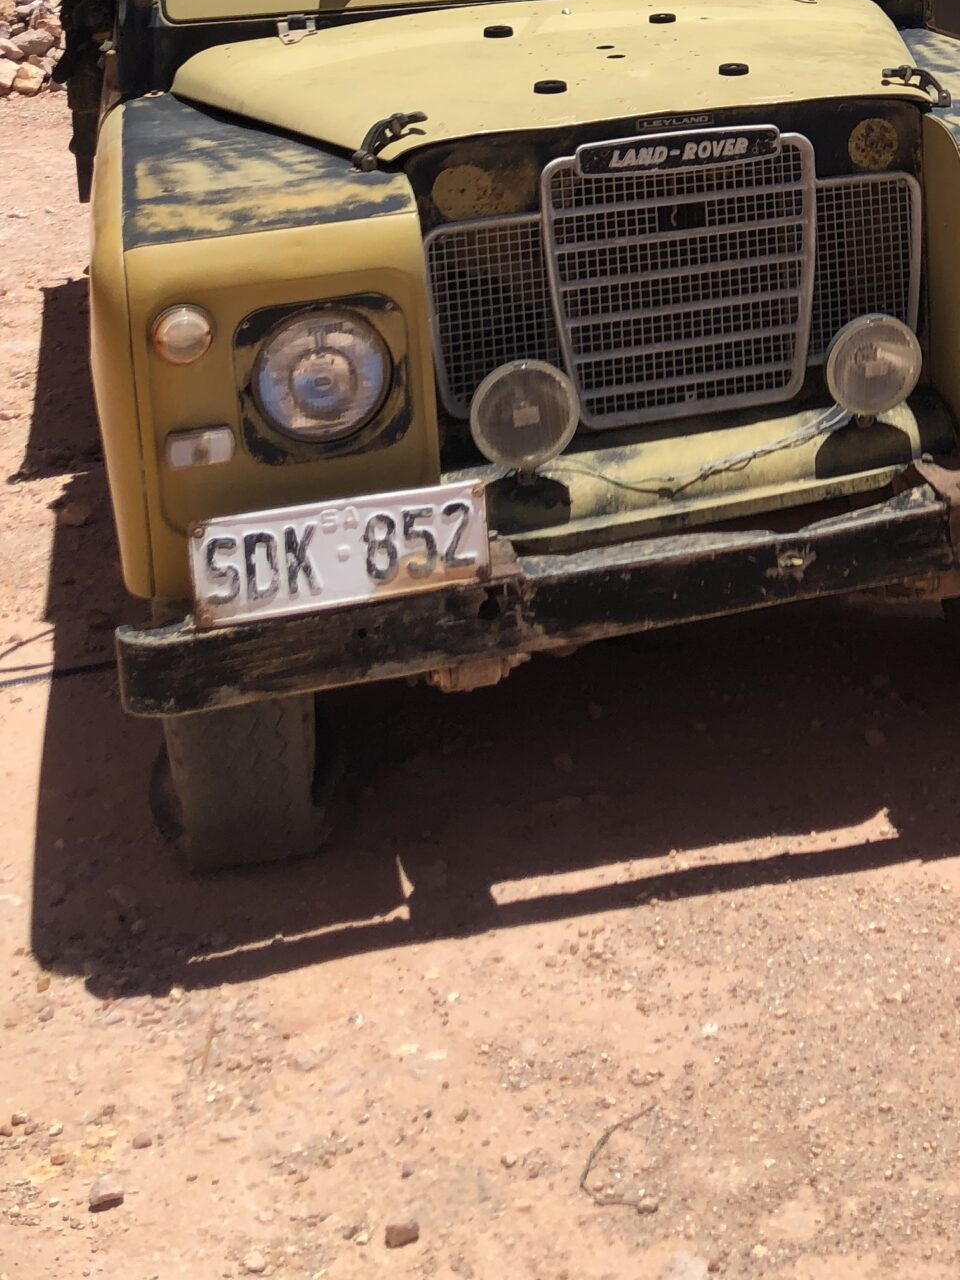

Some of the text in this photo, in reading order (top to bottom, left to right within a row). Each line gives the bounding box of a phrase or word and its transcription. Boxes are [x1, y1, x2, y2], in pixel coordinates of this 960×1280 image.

[642, 116, 709, 128] LEYLAND
[609, 137, 749, 167] LAND-ROVER
[205, 502, 477, 606] SDK 852
